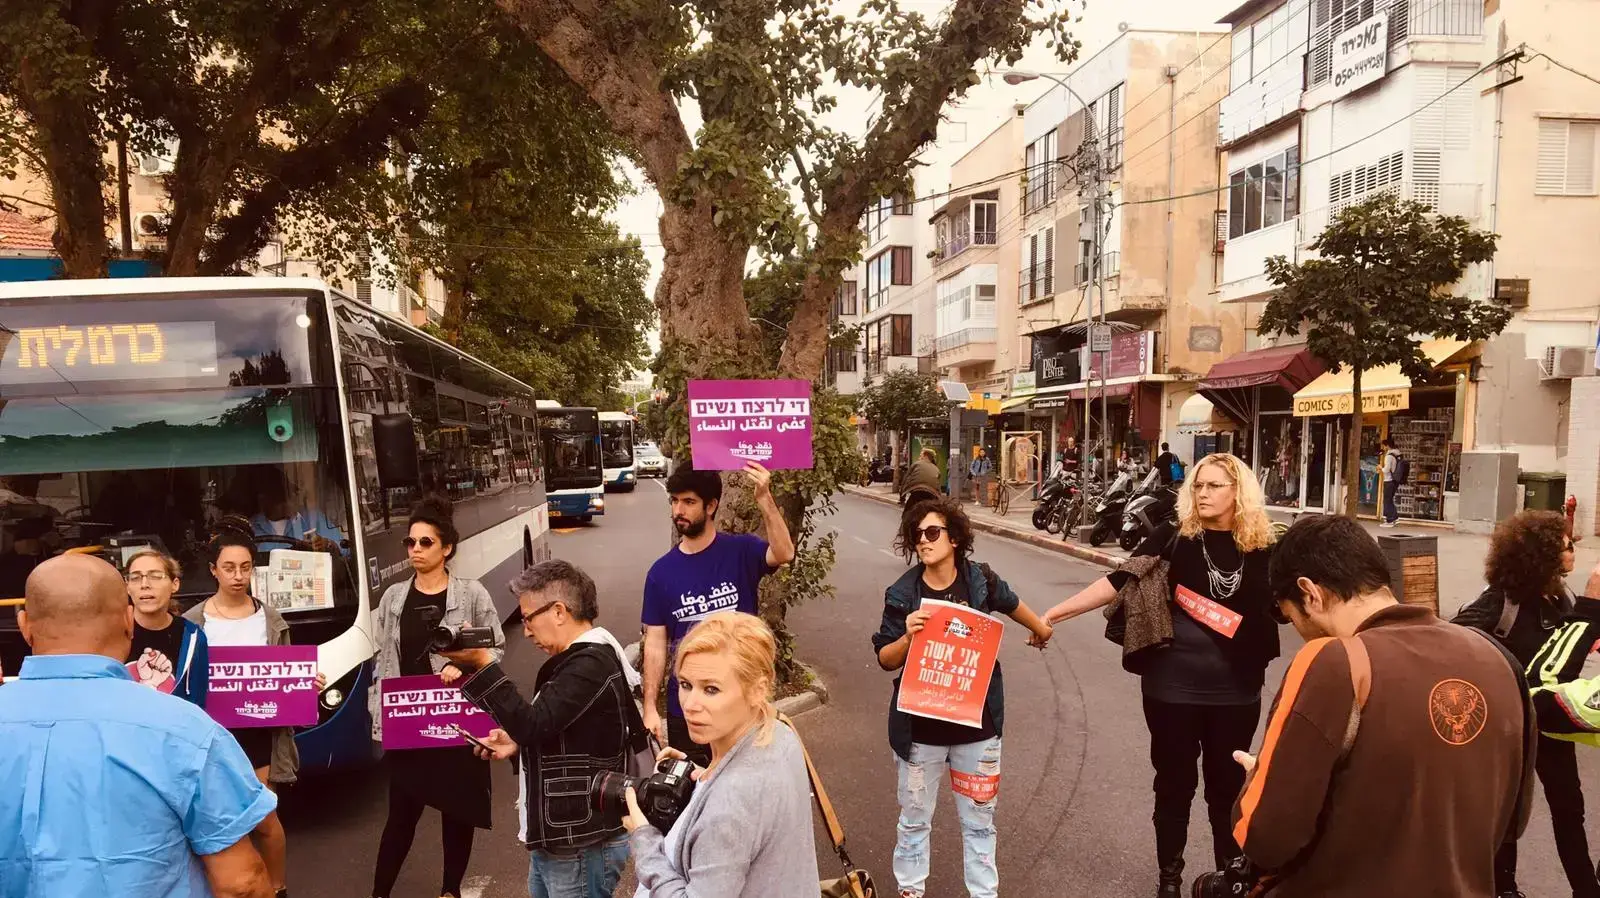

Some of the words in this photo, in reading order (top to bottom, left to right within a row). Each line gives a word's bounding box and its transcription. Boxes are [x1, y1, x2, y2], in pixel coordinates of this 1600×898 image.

[1341, 22, 1382, 55] למכירה
[18, 324, 164, 368] כרמלית
[696, 401, 736, 414] נשים
[741, 397, 785, 413] לרצח
[789, 401, 805, 413] די
[1298, 399, 1333, 413] COMICS
[696, 419, 736, 432] النساء
[740, 416, 772, 431] لقتل
[776, 417, 806, 432] كفى
[708, 582, 738, 599] نقف
[698, 592, 739, 613] עומדים
[672, 605, 697, 619] ביחד
[923, 640, 956, 662] אשה
[960, 647, 981, 668] אני
[249, 661, 292, 675] לרצח
[297, 664, 313, 675] די
[918, 667, 953, 687] שובתת
[956, 676, 973, 691] אני
[208, 681, 243, 692] النسا
[246, 679, 279, 692] لقتل
[282, 679, 313, 693] كفى
[388, 691, 427, 704] נשים
[432, 690, 465, 701] רצח
[388, 705, 426, 718] النساء
[429, 702, 462, 716] لقتل
